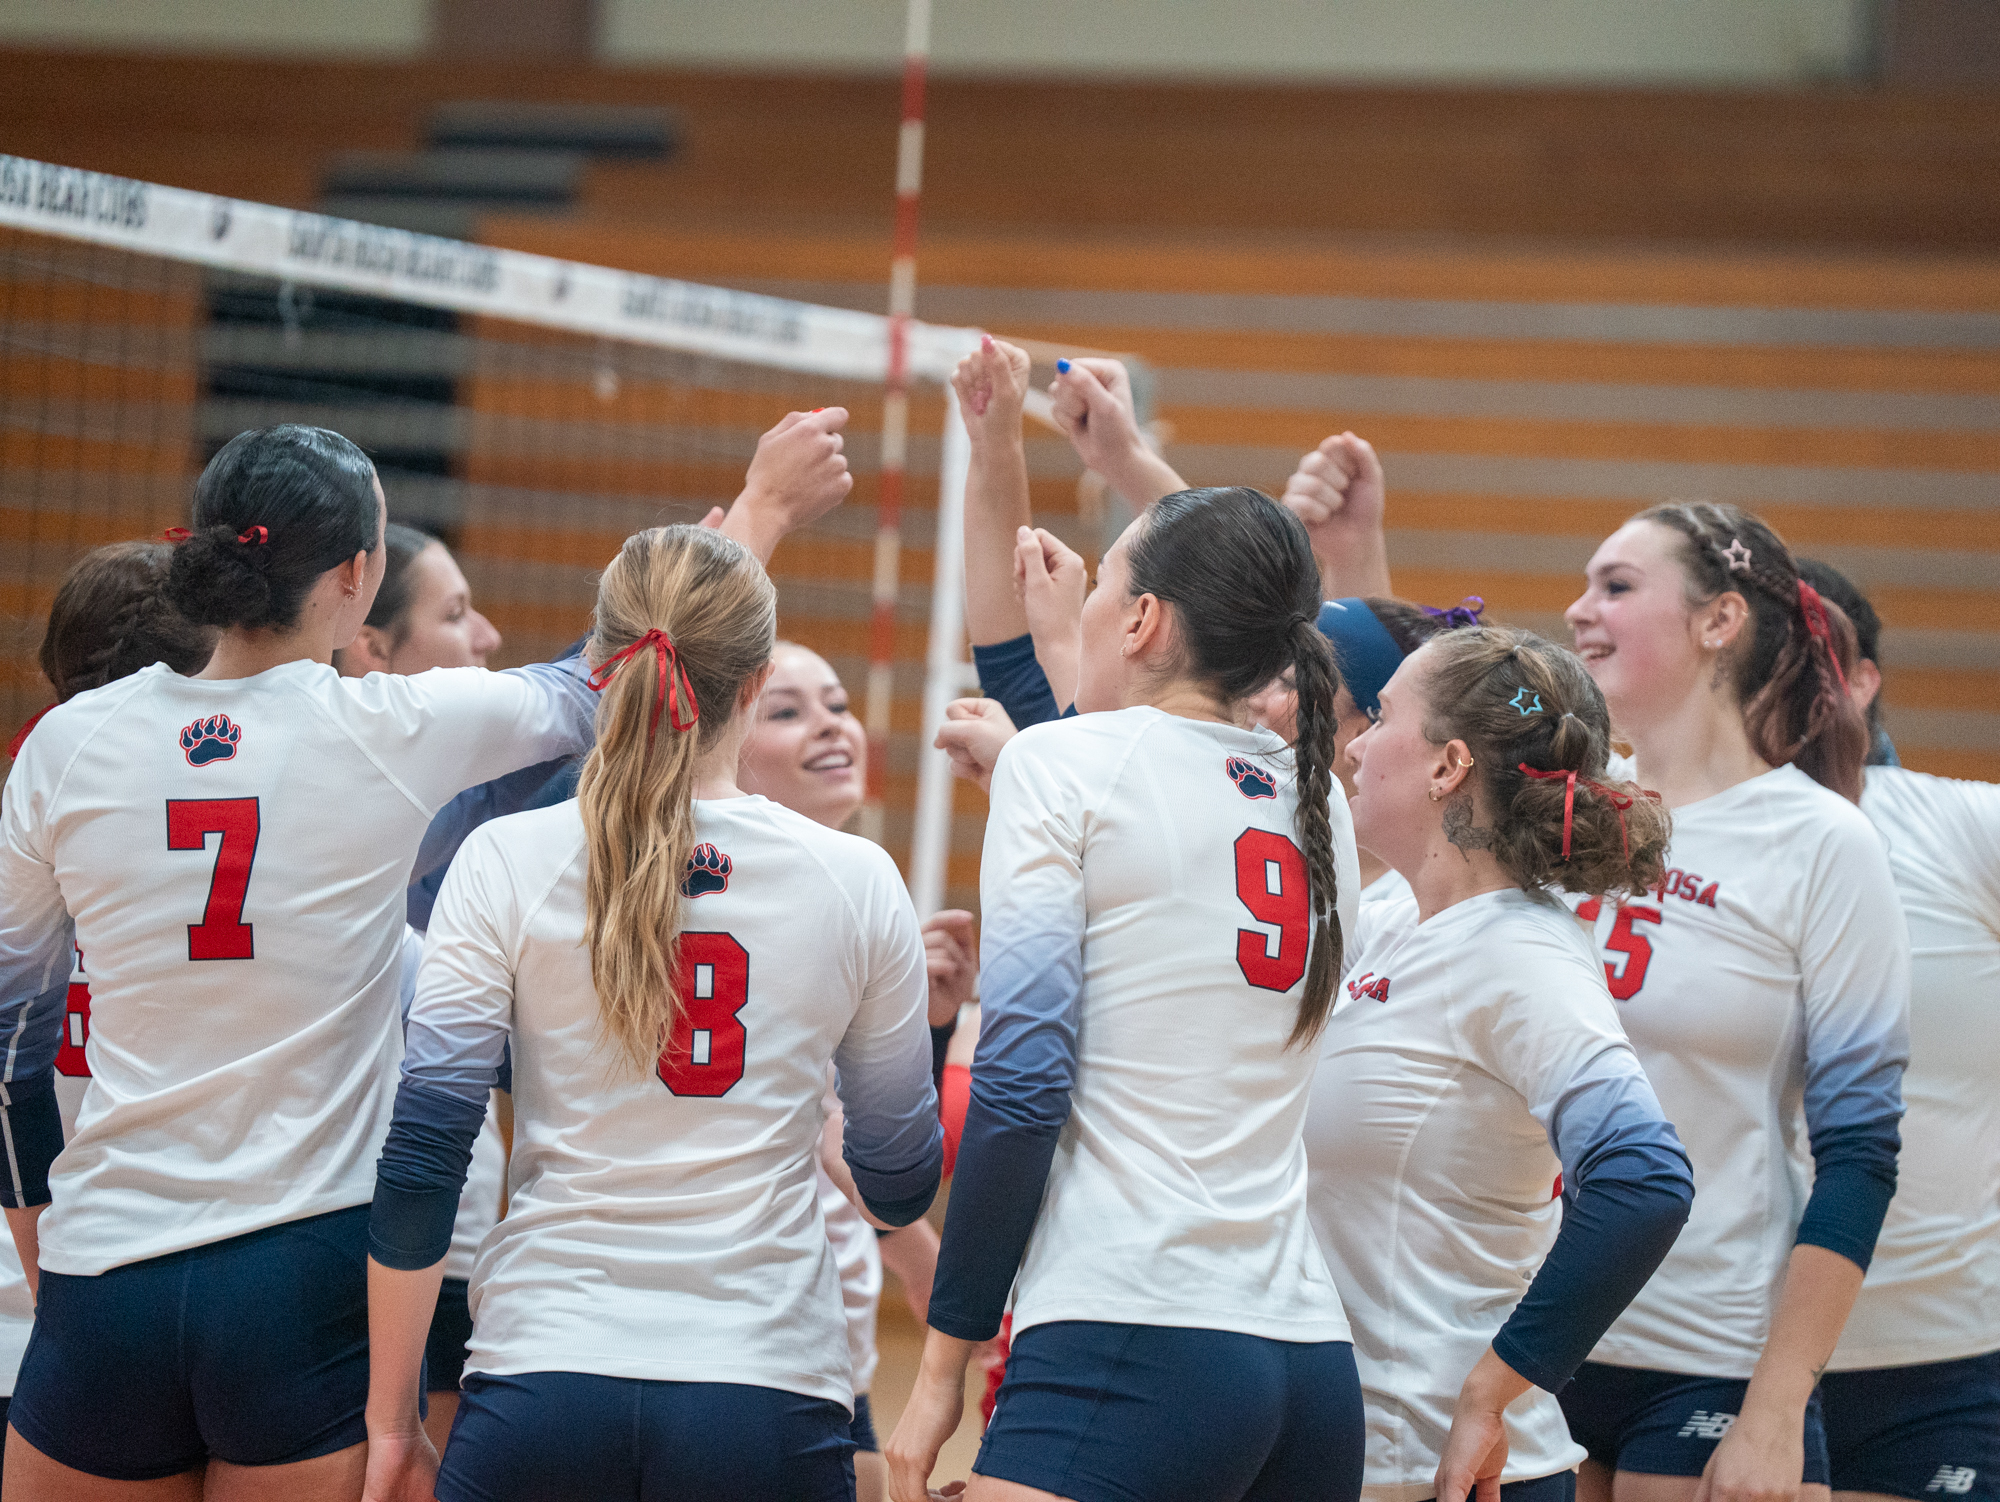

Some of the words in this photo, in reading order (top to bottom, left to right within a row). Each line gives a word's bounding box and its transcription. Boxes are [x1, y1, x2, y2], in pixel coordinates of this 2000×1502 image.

[166, 796, 261, 961] 7
[1233, 826, 1311, 993] 9
[1648, 867, 1720, 909] OSA
[656, 931, 750, 1097] 8
[1924, 1463, 1978, 1495] NB
